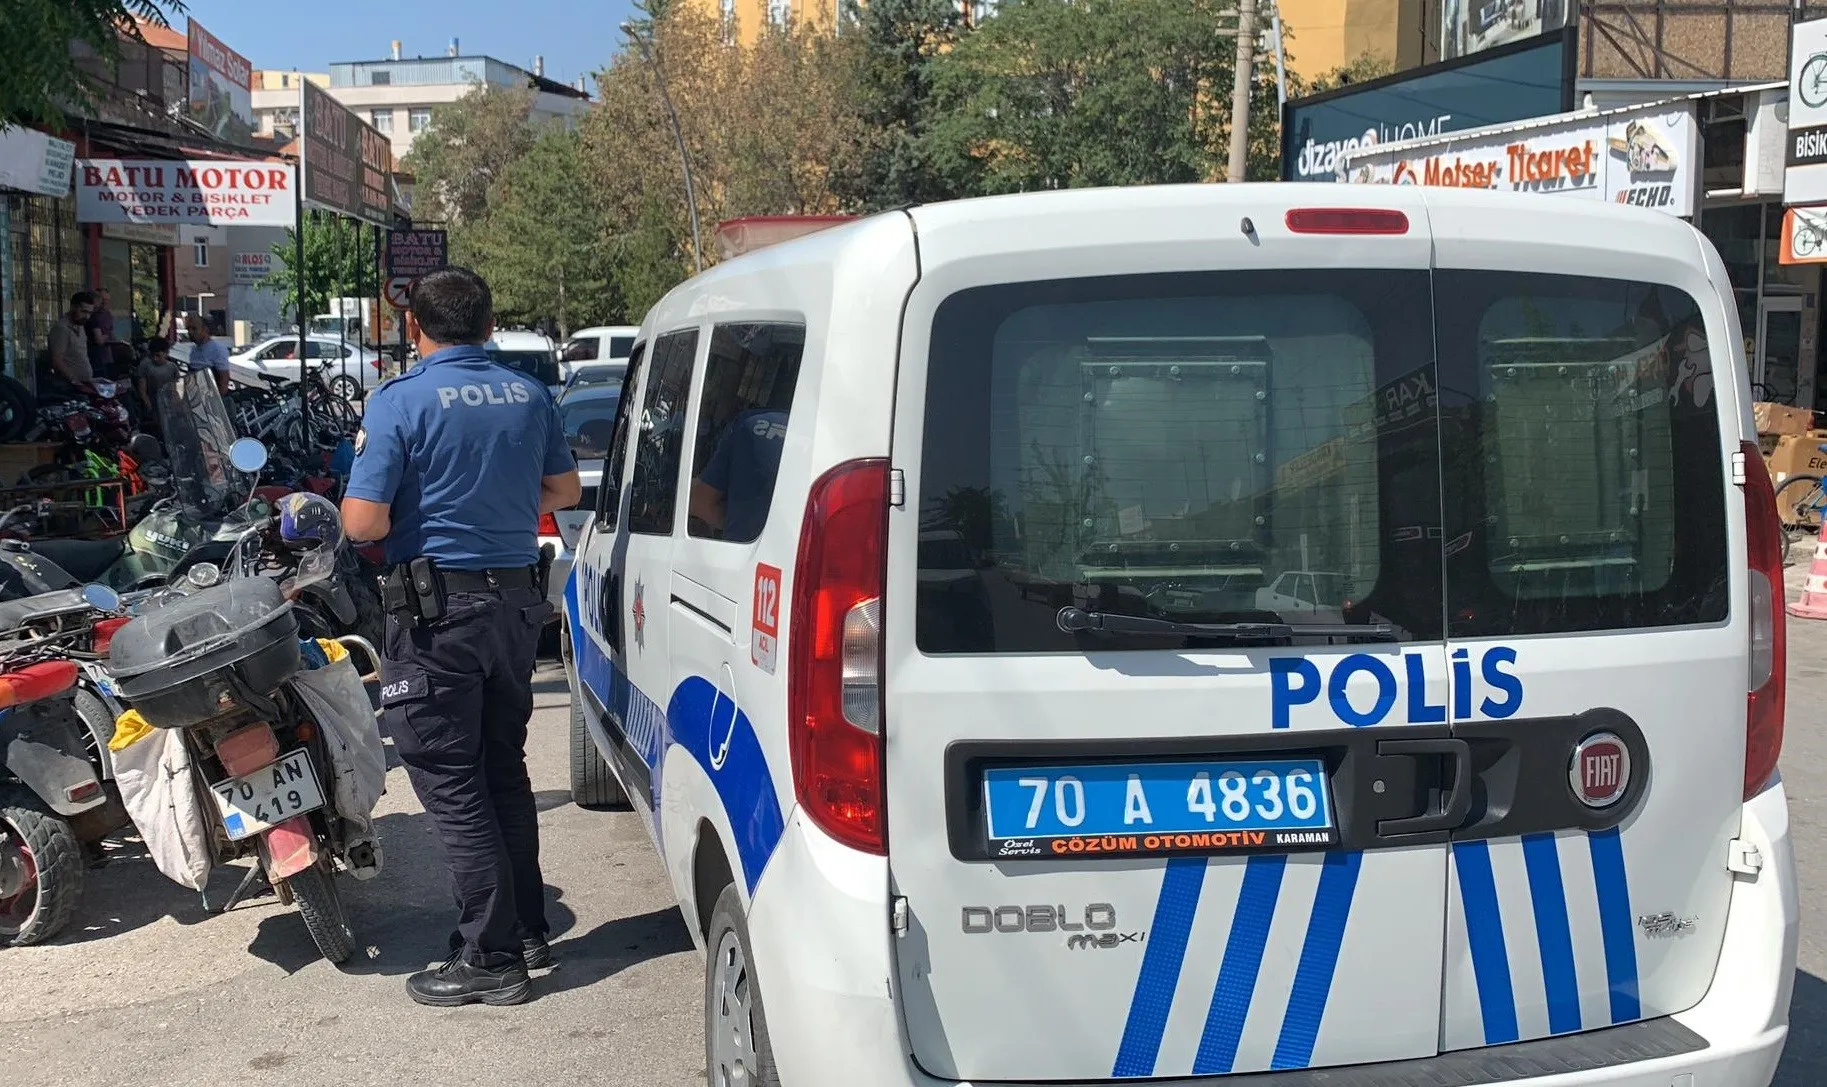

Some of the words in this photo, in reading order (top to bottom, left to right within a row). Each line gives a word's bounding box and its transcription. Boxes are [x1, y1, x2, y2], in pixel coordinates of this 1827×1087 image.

[1507, 140, 1593, 183] Ticaret
[84, 166, 164, 189] BATU
[176, 168, 287, 190] MOTOR
[99, 191, 164, 202] MOTOR
[171, 193, 186, 203] &
[1627, 185, 1671, 207] ECHO
[121, 205, 180, 216] YEDEK
[187, 206, 249, 220] PARÇA
[391, 232, 443, 245] BATU
[436, 381, 530, 409] POLİS
[758, 575, 777, 628] 112
[381, 680, 409, 700] POLİS
[1269, 646, 1524, 729] POLİS
[220, 781, 254, 808] 70
[272, 759, 303, 789] AN
[1586, 754, 1620, 788] FIAT
[254, 790, 302, 823] 419
[1018, 774, 1085, 829] 70
[1123, 773, 1154, 825] A
[1186, 768, 1317, 823] 4836
[998, 847, 1042, 856] Servis
[1003, 839, 1034, 848] Özel
[1051, 834, 1137, 854] ÇÖZÜM
[1144, 830, 1265, 850] OTOMOTİV
[1276, 832, 1329, 844] KARAMAN
[961, 902, 1117, 934] DOBLO
